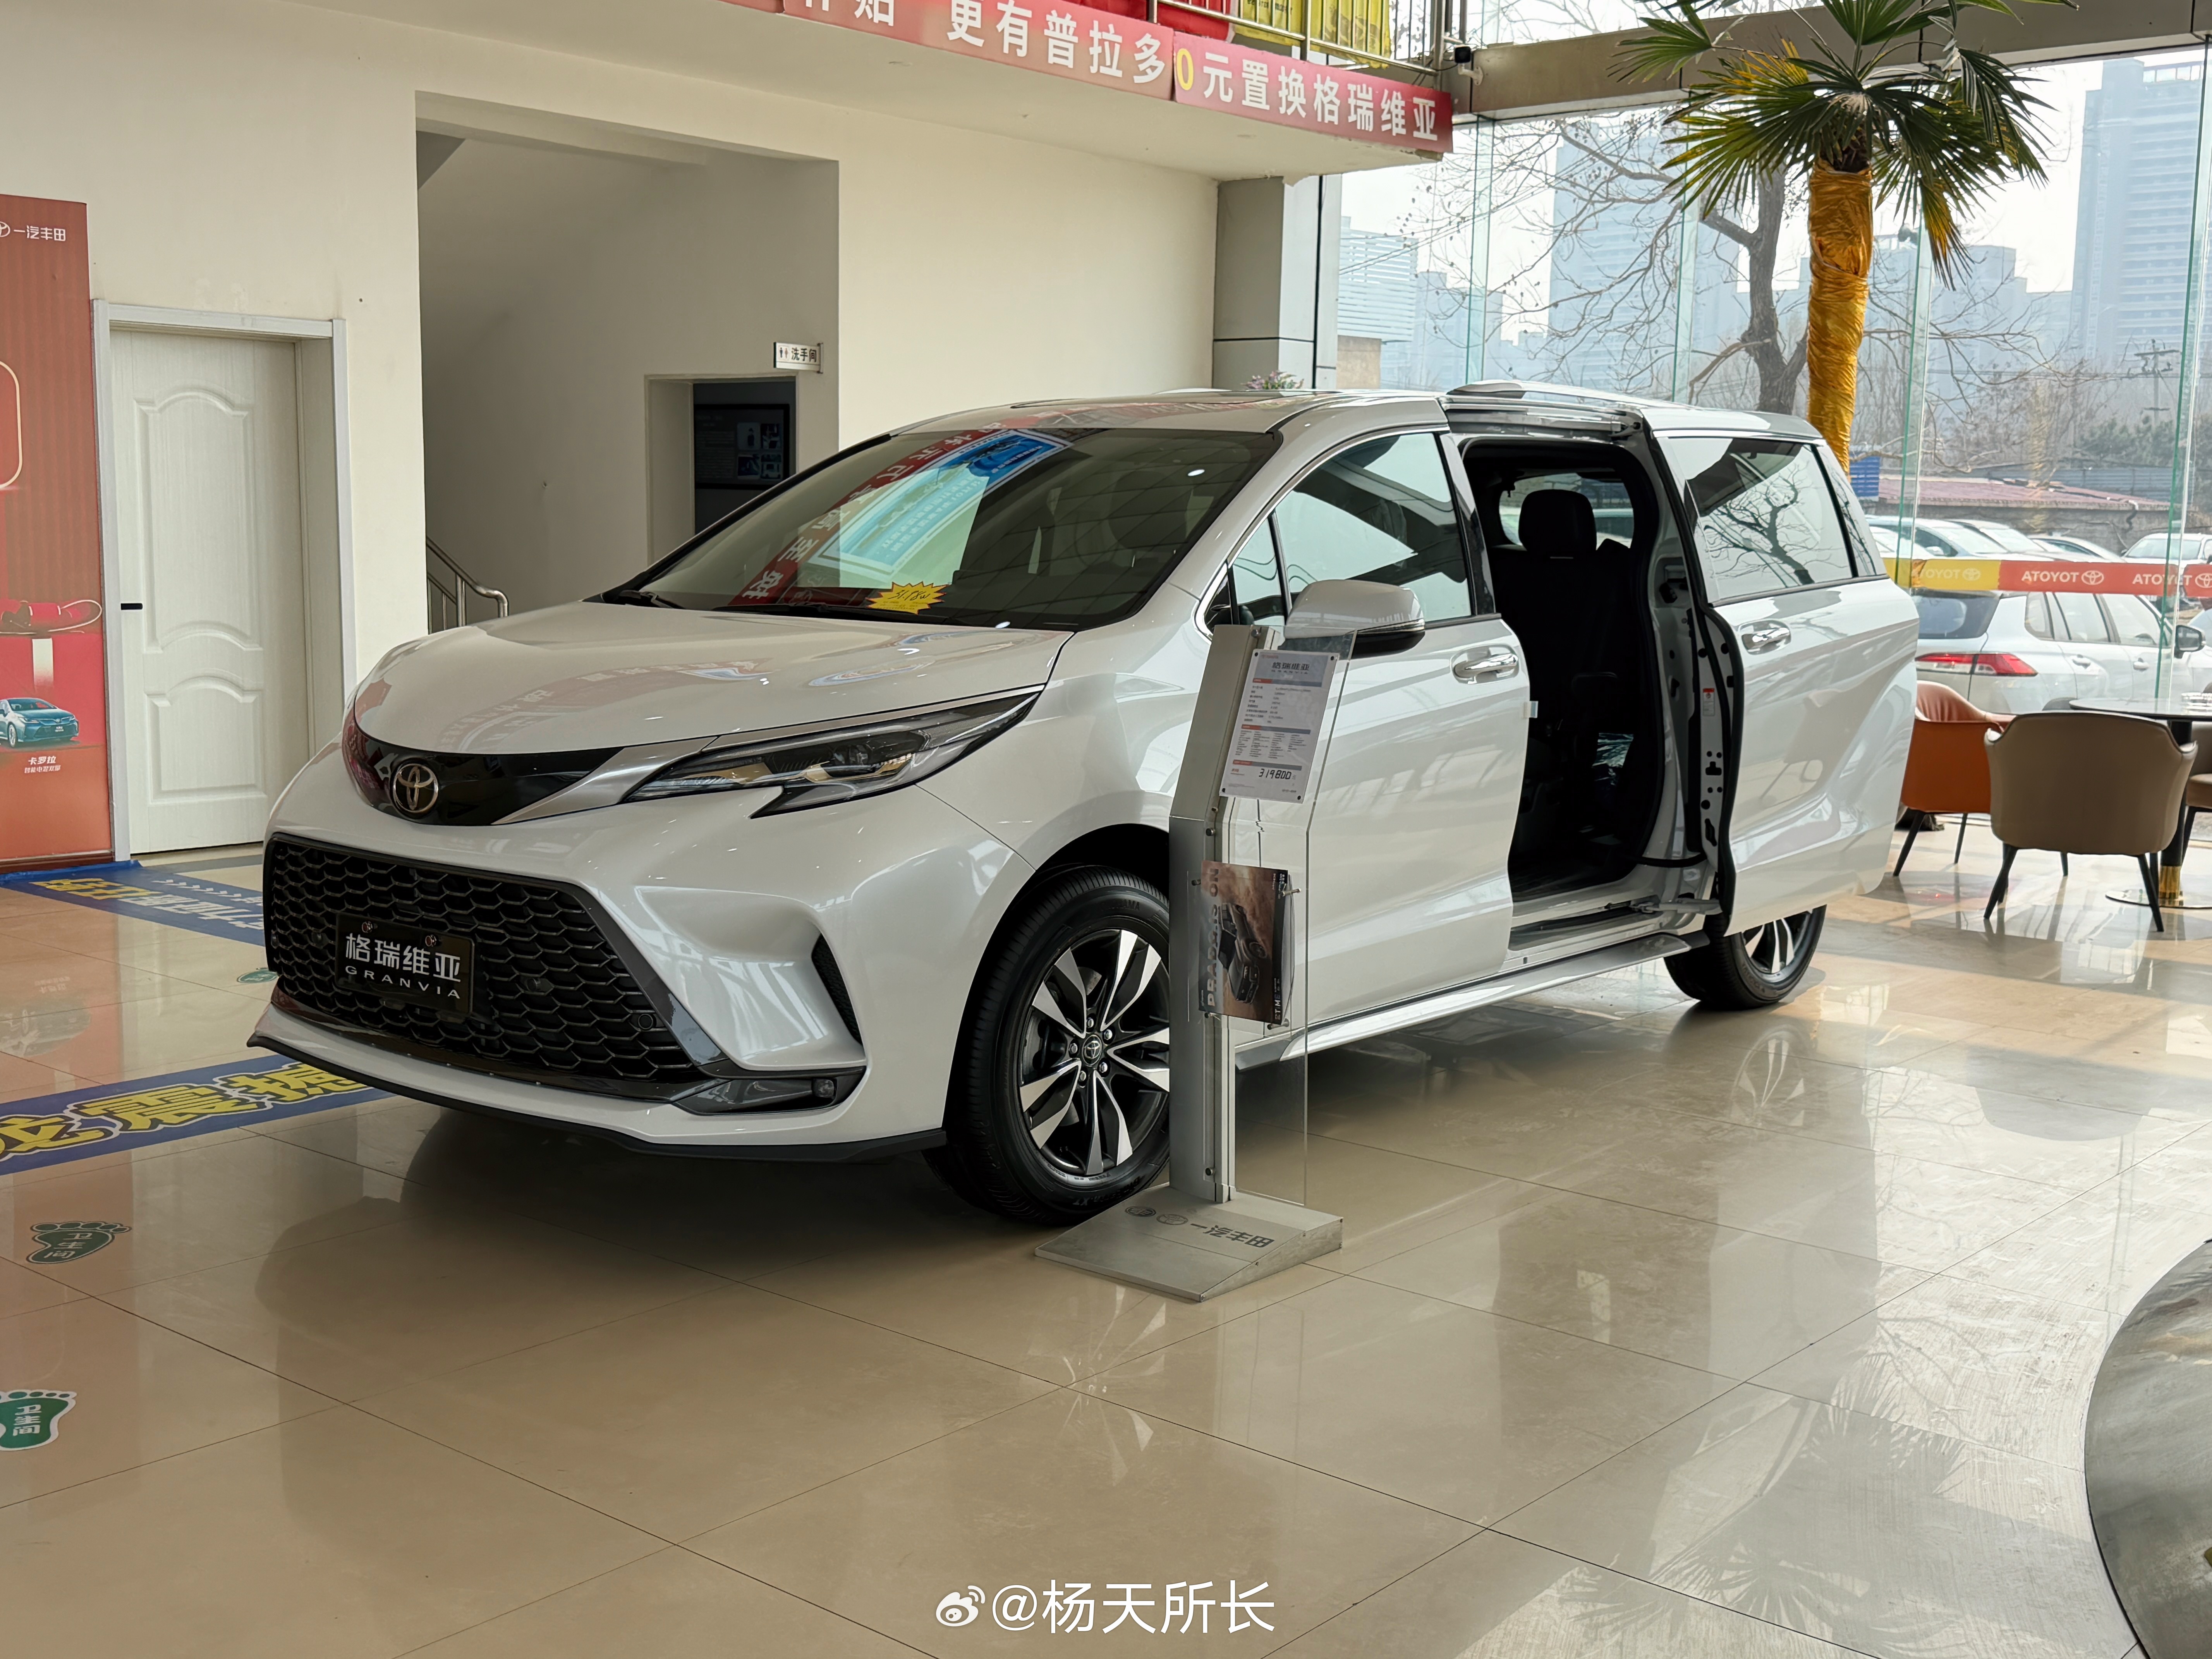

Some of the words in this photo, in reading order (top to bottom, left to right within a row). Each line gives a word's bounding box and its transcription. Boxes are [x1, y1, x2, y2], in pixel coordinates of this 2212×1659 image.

[14, 225, 66, 241] 一汽丰田
[791, 347, 817, 362] 洗手间
[1272, 661, 1310, 671] 格瑞维亚
[28, 756, 57, 765] 卡罗拉
[1258, 768, 1292, 780] 319800
[345, 933, 461, 982] 格瑞维亚
[345, 965, 460, 999] GRANVIA
[44, 1232, 93, 1259] 卫生间
[1190, 1223, 1275, 1248] 一汽丰田
[13, 1404, 42, 1436] 卫生间
